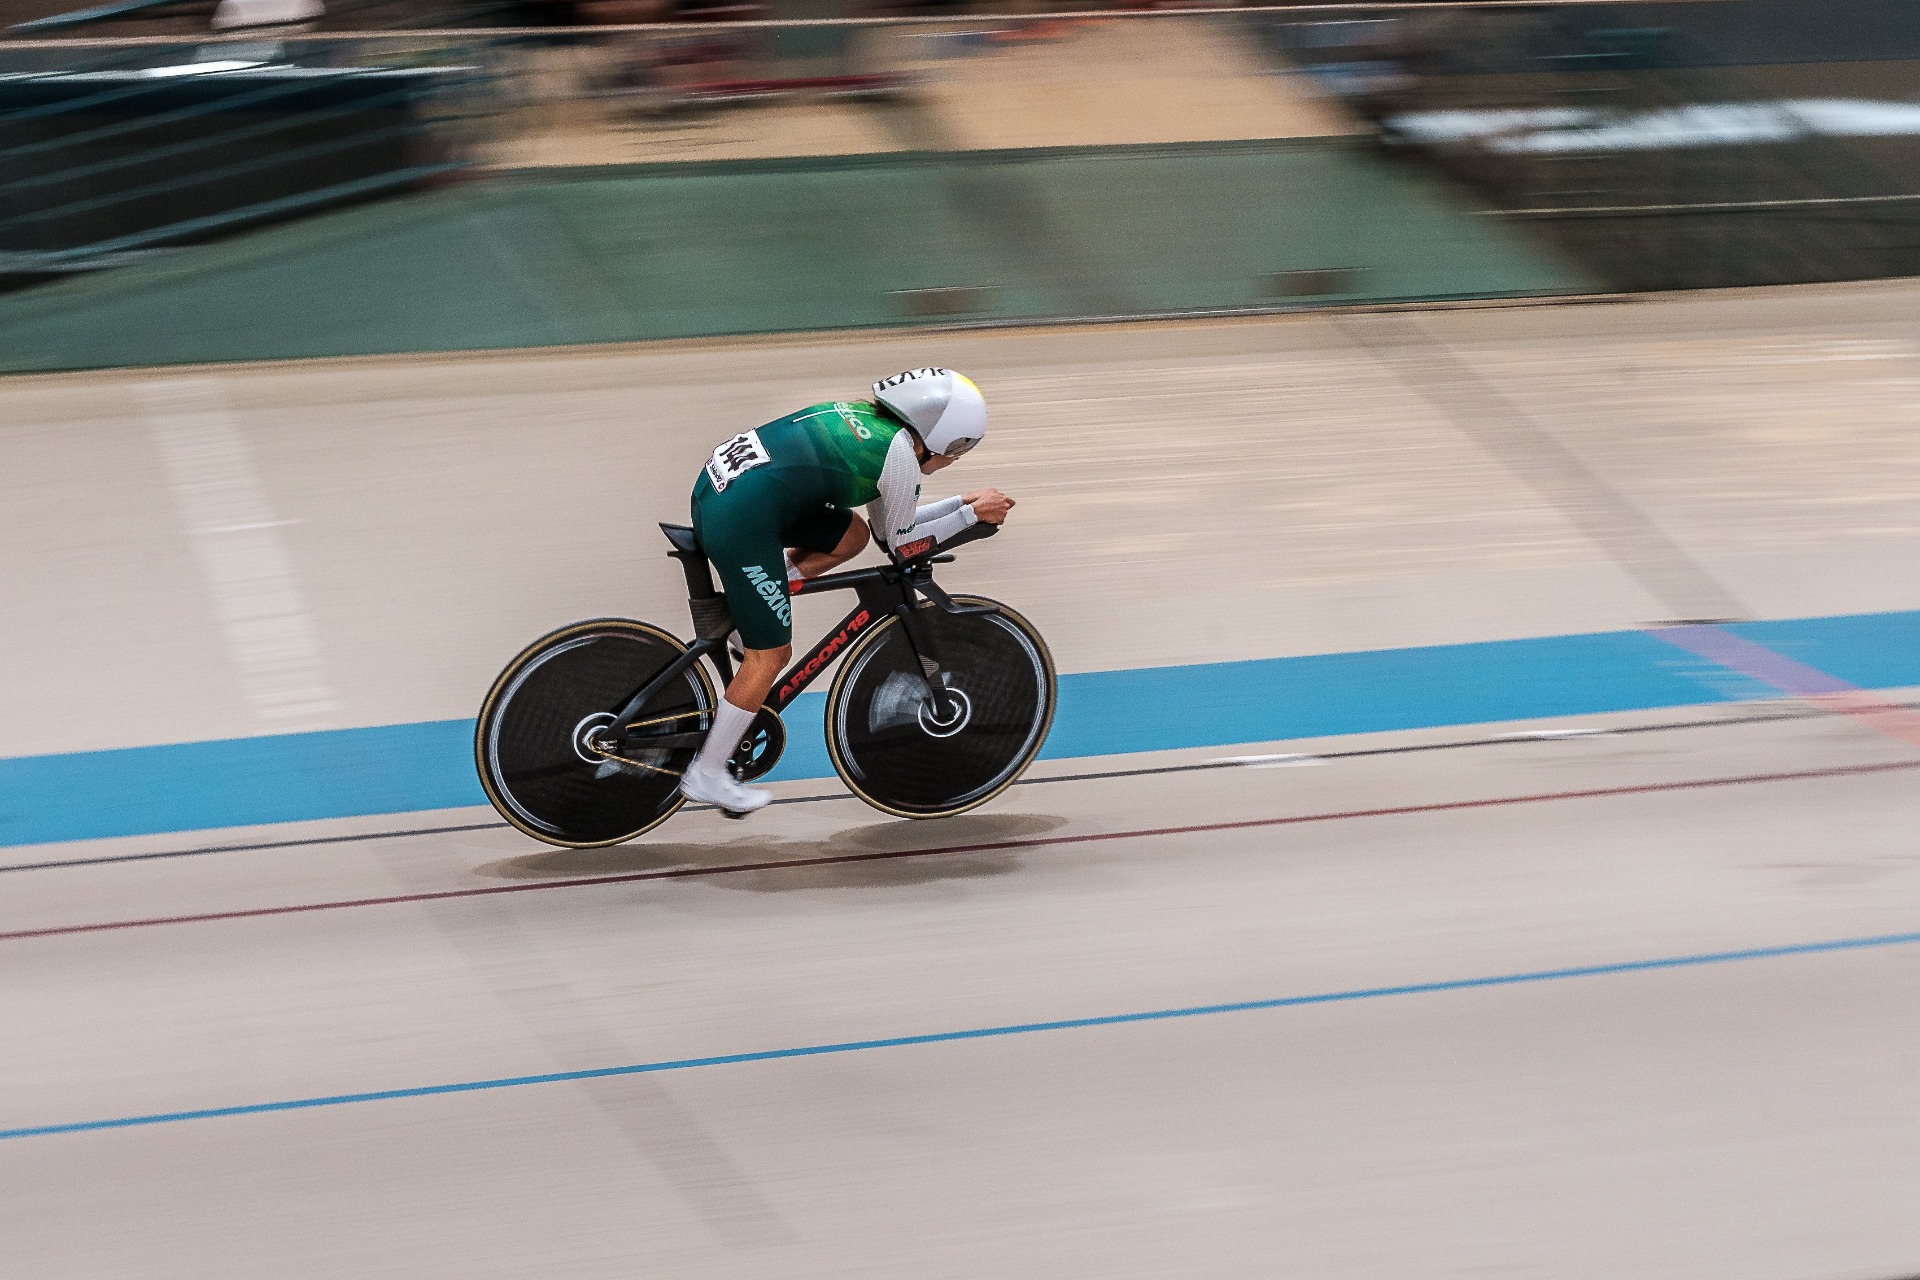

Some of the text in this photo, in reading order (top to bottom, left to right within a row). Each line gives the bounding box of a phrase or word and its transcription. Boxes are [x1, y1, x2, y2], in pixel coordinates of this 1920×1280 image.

[719, 436, 758, 472] 144
[780, 610, 870, 702] ARGON 18
